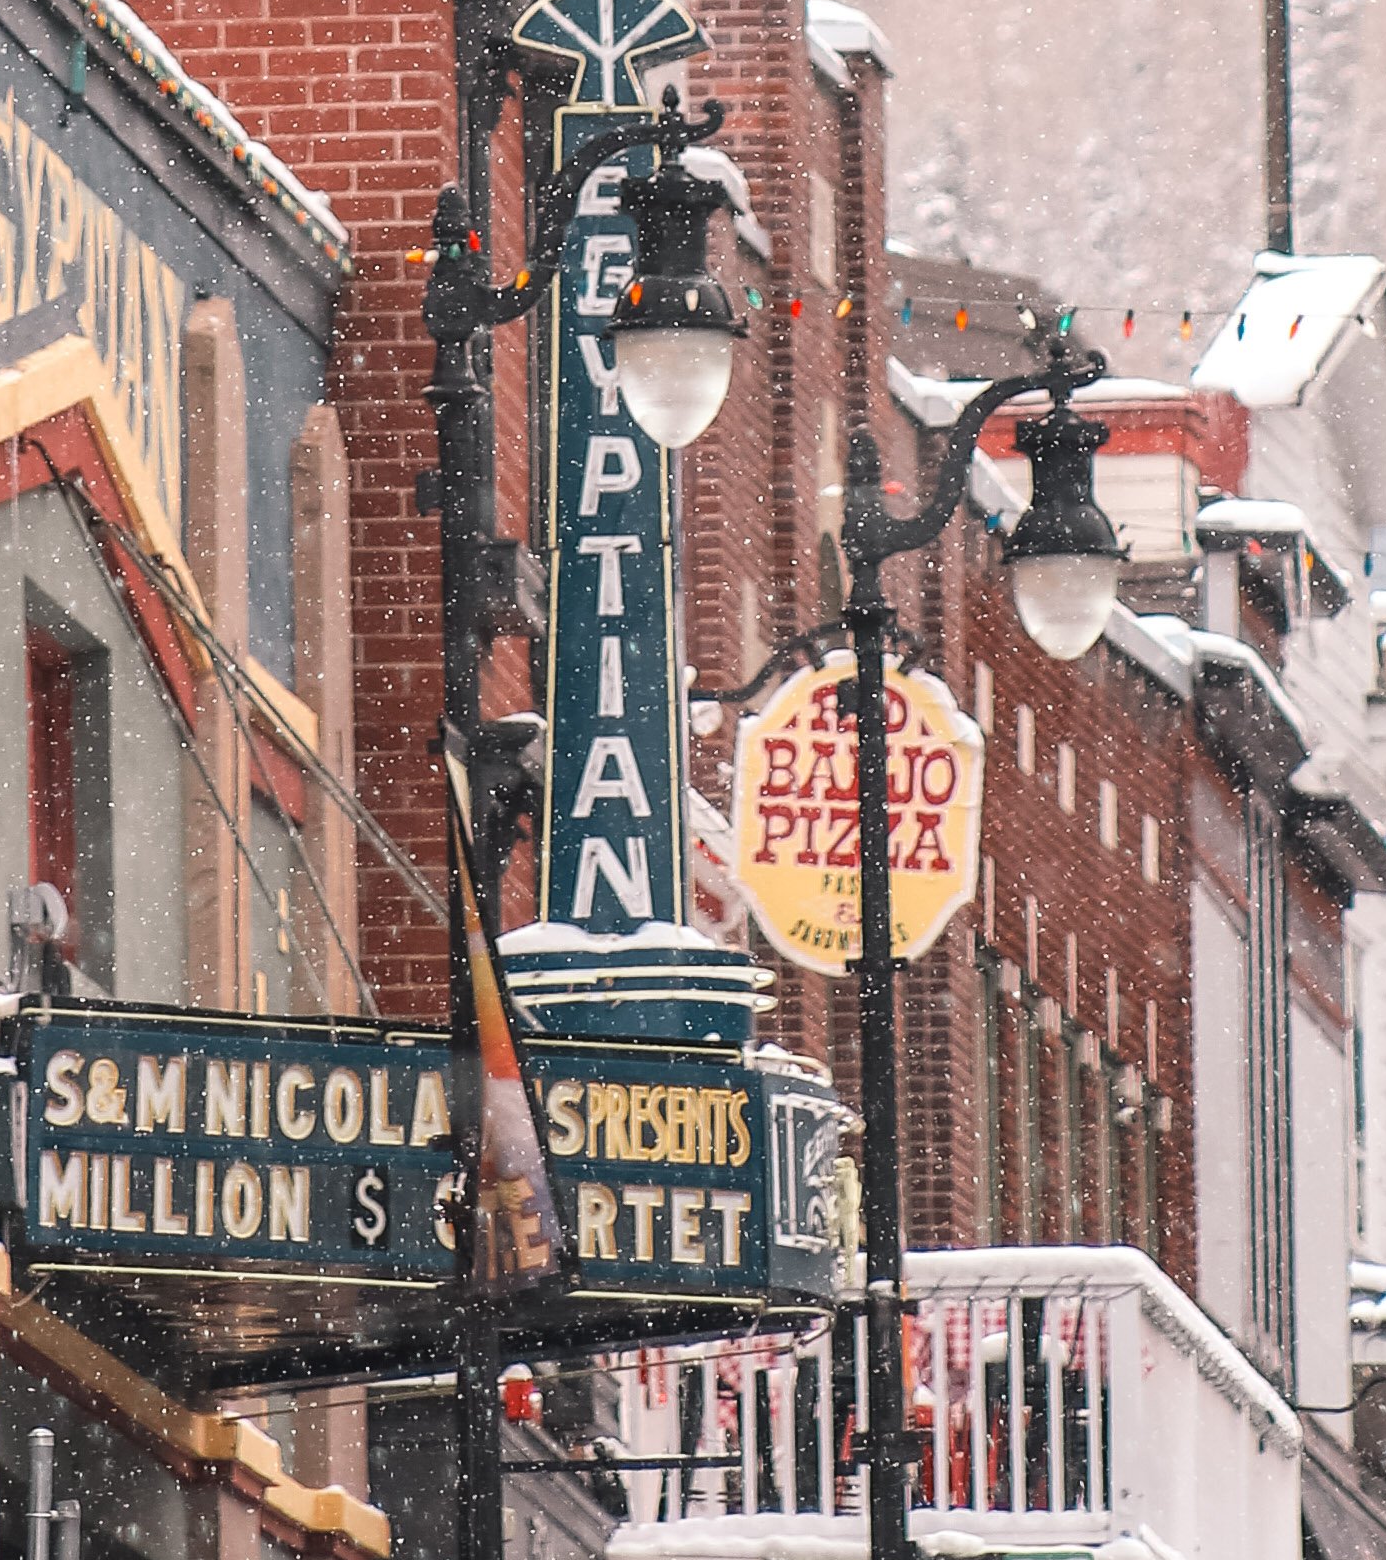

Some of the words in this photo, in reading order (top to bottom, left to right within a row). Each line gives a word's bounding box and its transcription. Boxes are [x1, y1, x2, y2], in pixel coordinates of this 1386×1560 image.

[760, 737, 957, 805] BAJO
[43, 1047, 186, 1134] S&M
[586, 1080, 752, 1169] PRESENTS
[38, 1148, 312, 1245] MILLION
[352, 1167, 387, 1248] $
